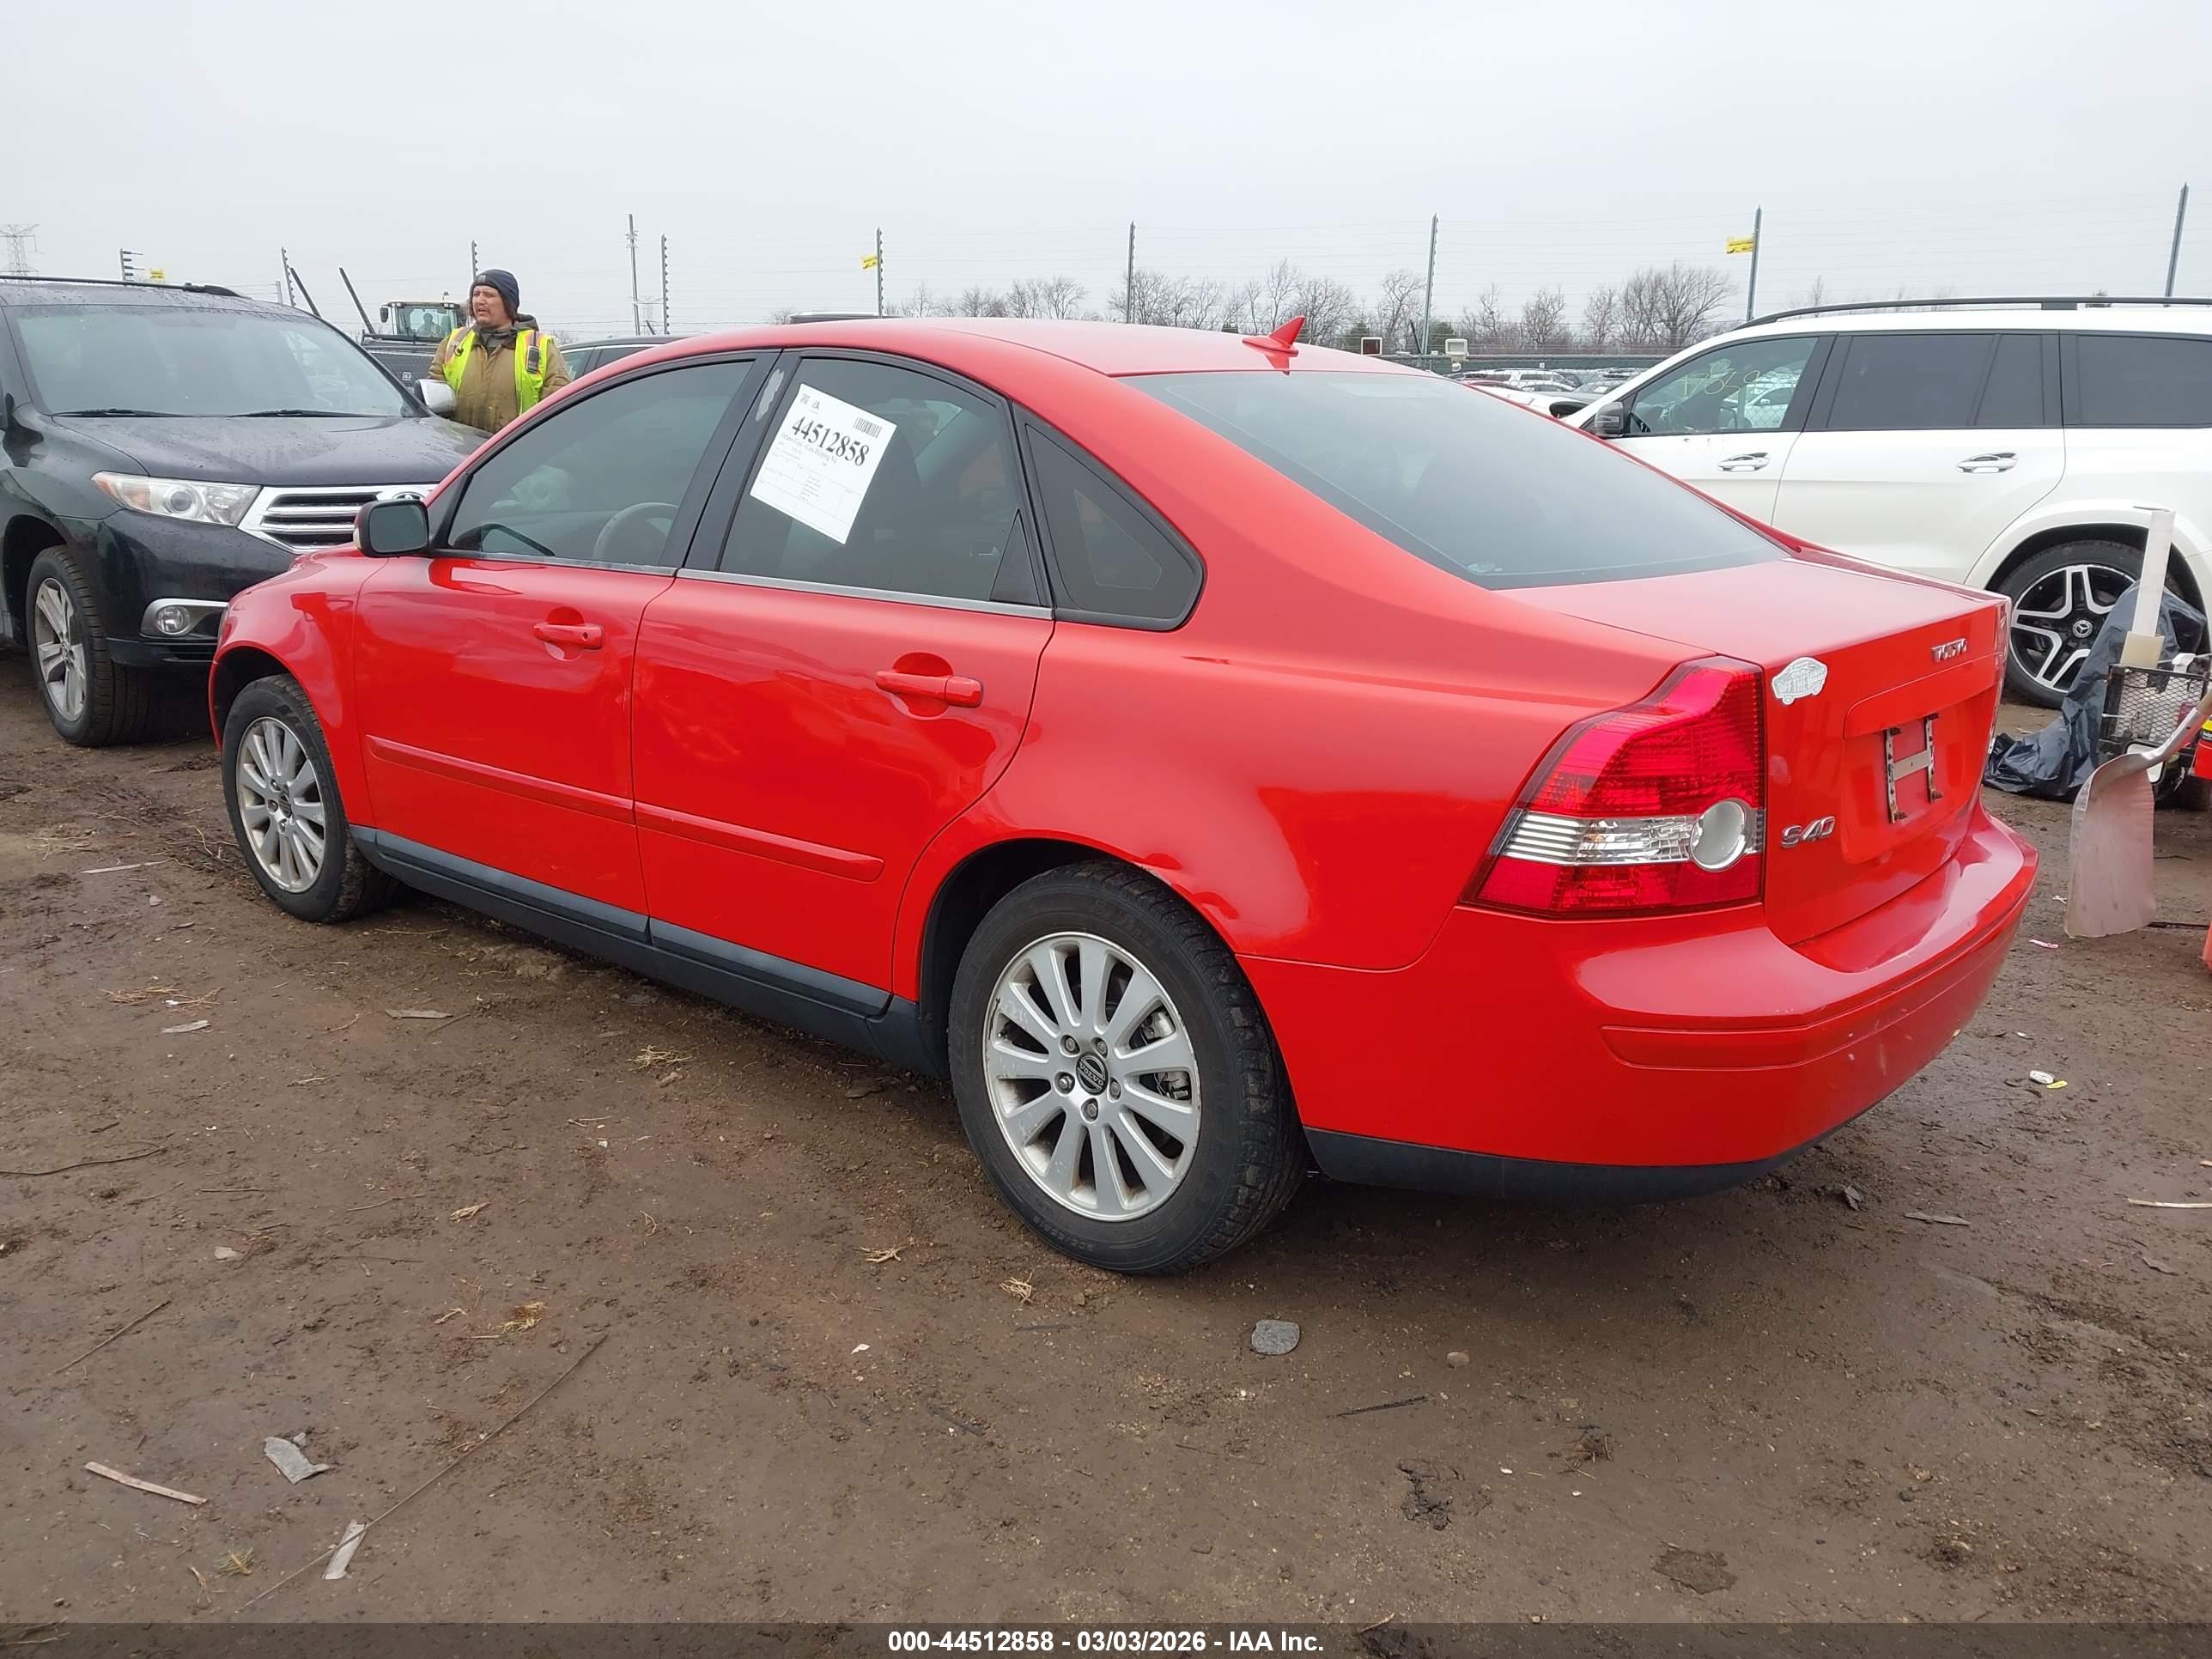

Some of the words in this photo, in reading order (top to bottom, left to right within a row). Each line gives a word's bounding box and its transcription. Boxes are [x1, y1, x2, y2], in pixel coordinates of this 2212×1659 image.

[792, 416, 869, 466] 44512858
[1781, 816, 1835, 847] S40
[1079, 1060, 1104, 1086] VOLVO
